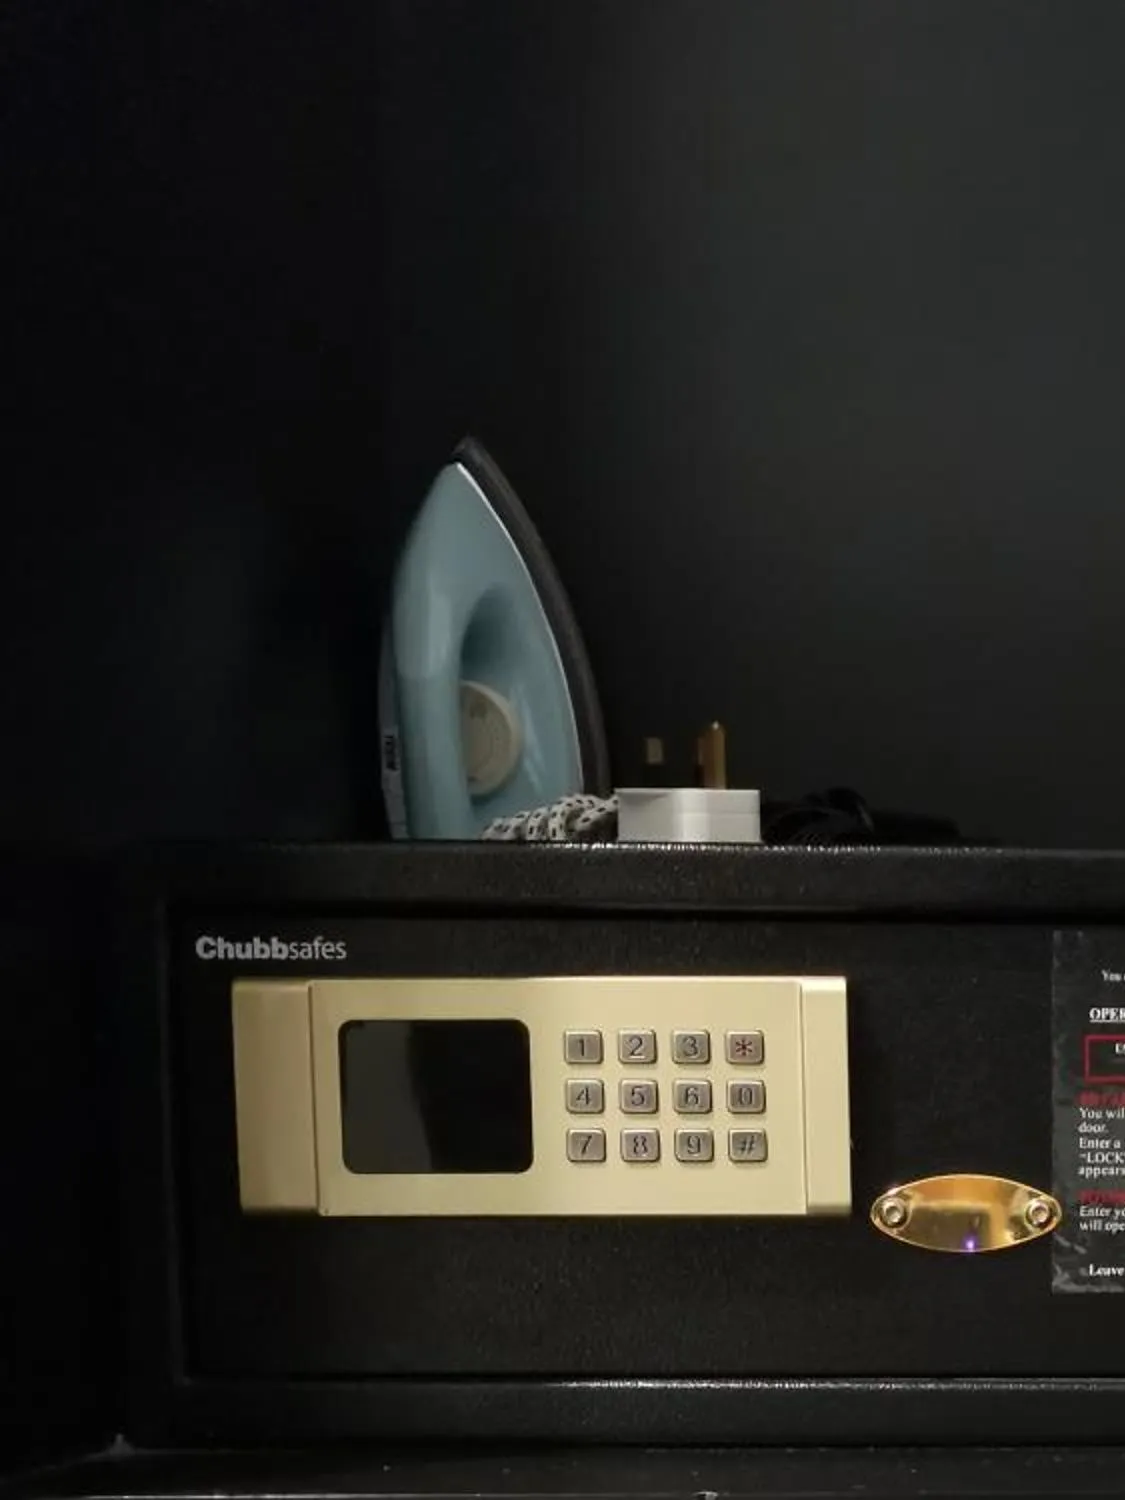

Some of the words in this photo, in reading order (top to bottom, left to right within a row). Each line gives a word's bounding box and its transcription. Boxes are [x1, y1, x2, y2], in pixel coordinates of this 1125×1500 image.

[195, 935, 347, 960] Chubbsafes
[1102, 970, 1121, 982] You
[629, 1037, 644, 1057] 2
[682, 1037, 699, 1057] 3
[576, 1087, 591, 1106] 4
[631, 1086, 646, 1106] 5
[684, 1086, 699, 1106] 6
[738, 1086, 753, 1106] 0
[1079, 1108, 1102, 1119] You
[1078, 1122, 1109, 1133] door.
[577, 1136, 592, 1155] 7
[633, 1135, 648, 1155] 8
[687, 1135, 702, 1155] 9
[1078, 1138, 1110, 1149] Enter
[1113, 1140, 1121, 1149] a
[1079, 1206, 1111, 1218] Enter
[1079, 1221, 1101, 1232] will
[1089, 1264, 1124, 1276] Leave
